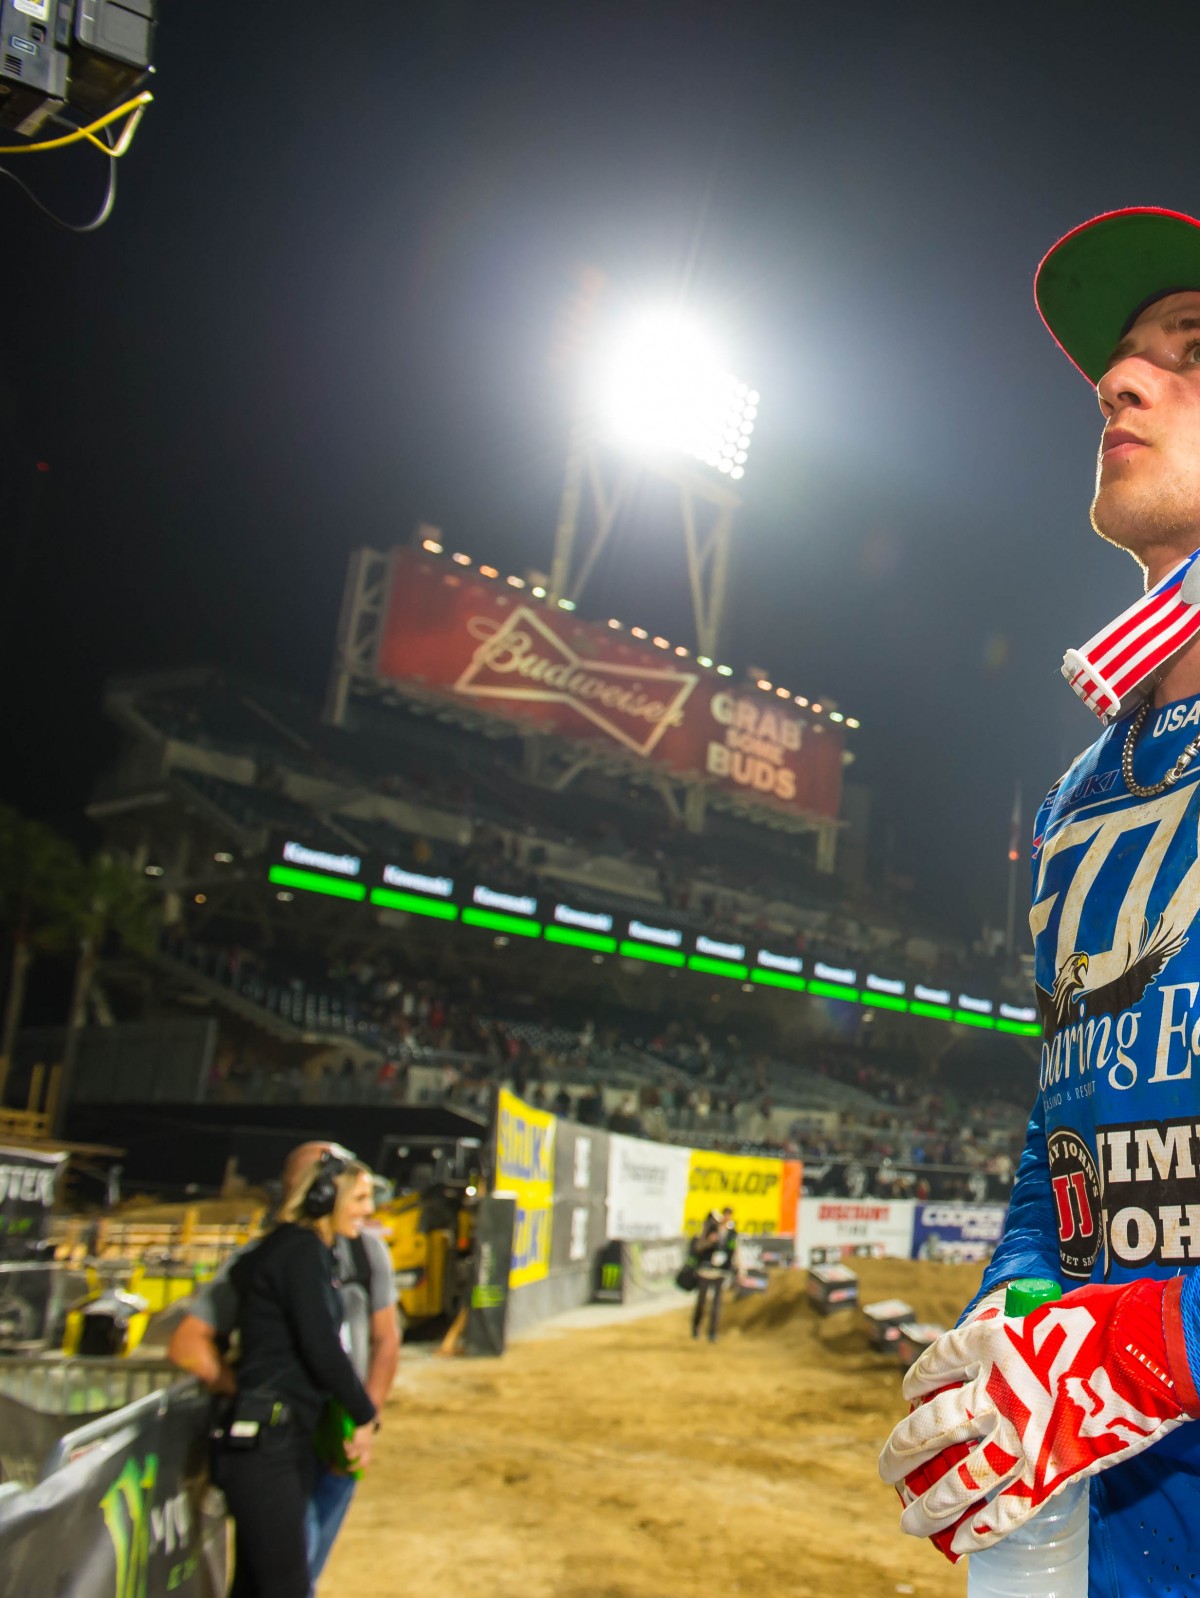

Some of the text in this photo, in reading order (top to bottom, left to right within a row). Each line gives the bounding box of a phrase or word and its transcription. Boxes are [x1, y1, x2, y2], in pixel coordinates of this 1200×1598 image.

[710, 692, 802, 751] GRAB
[1153, 700, 1200, 738] USA
[707, 741, 797, 799] BUDS
[1052, 1170, 1094, 1242] JJ
[1125, 1343, 1174, 1388] AIRLINE
